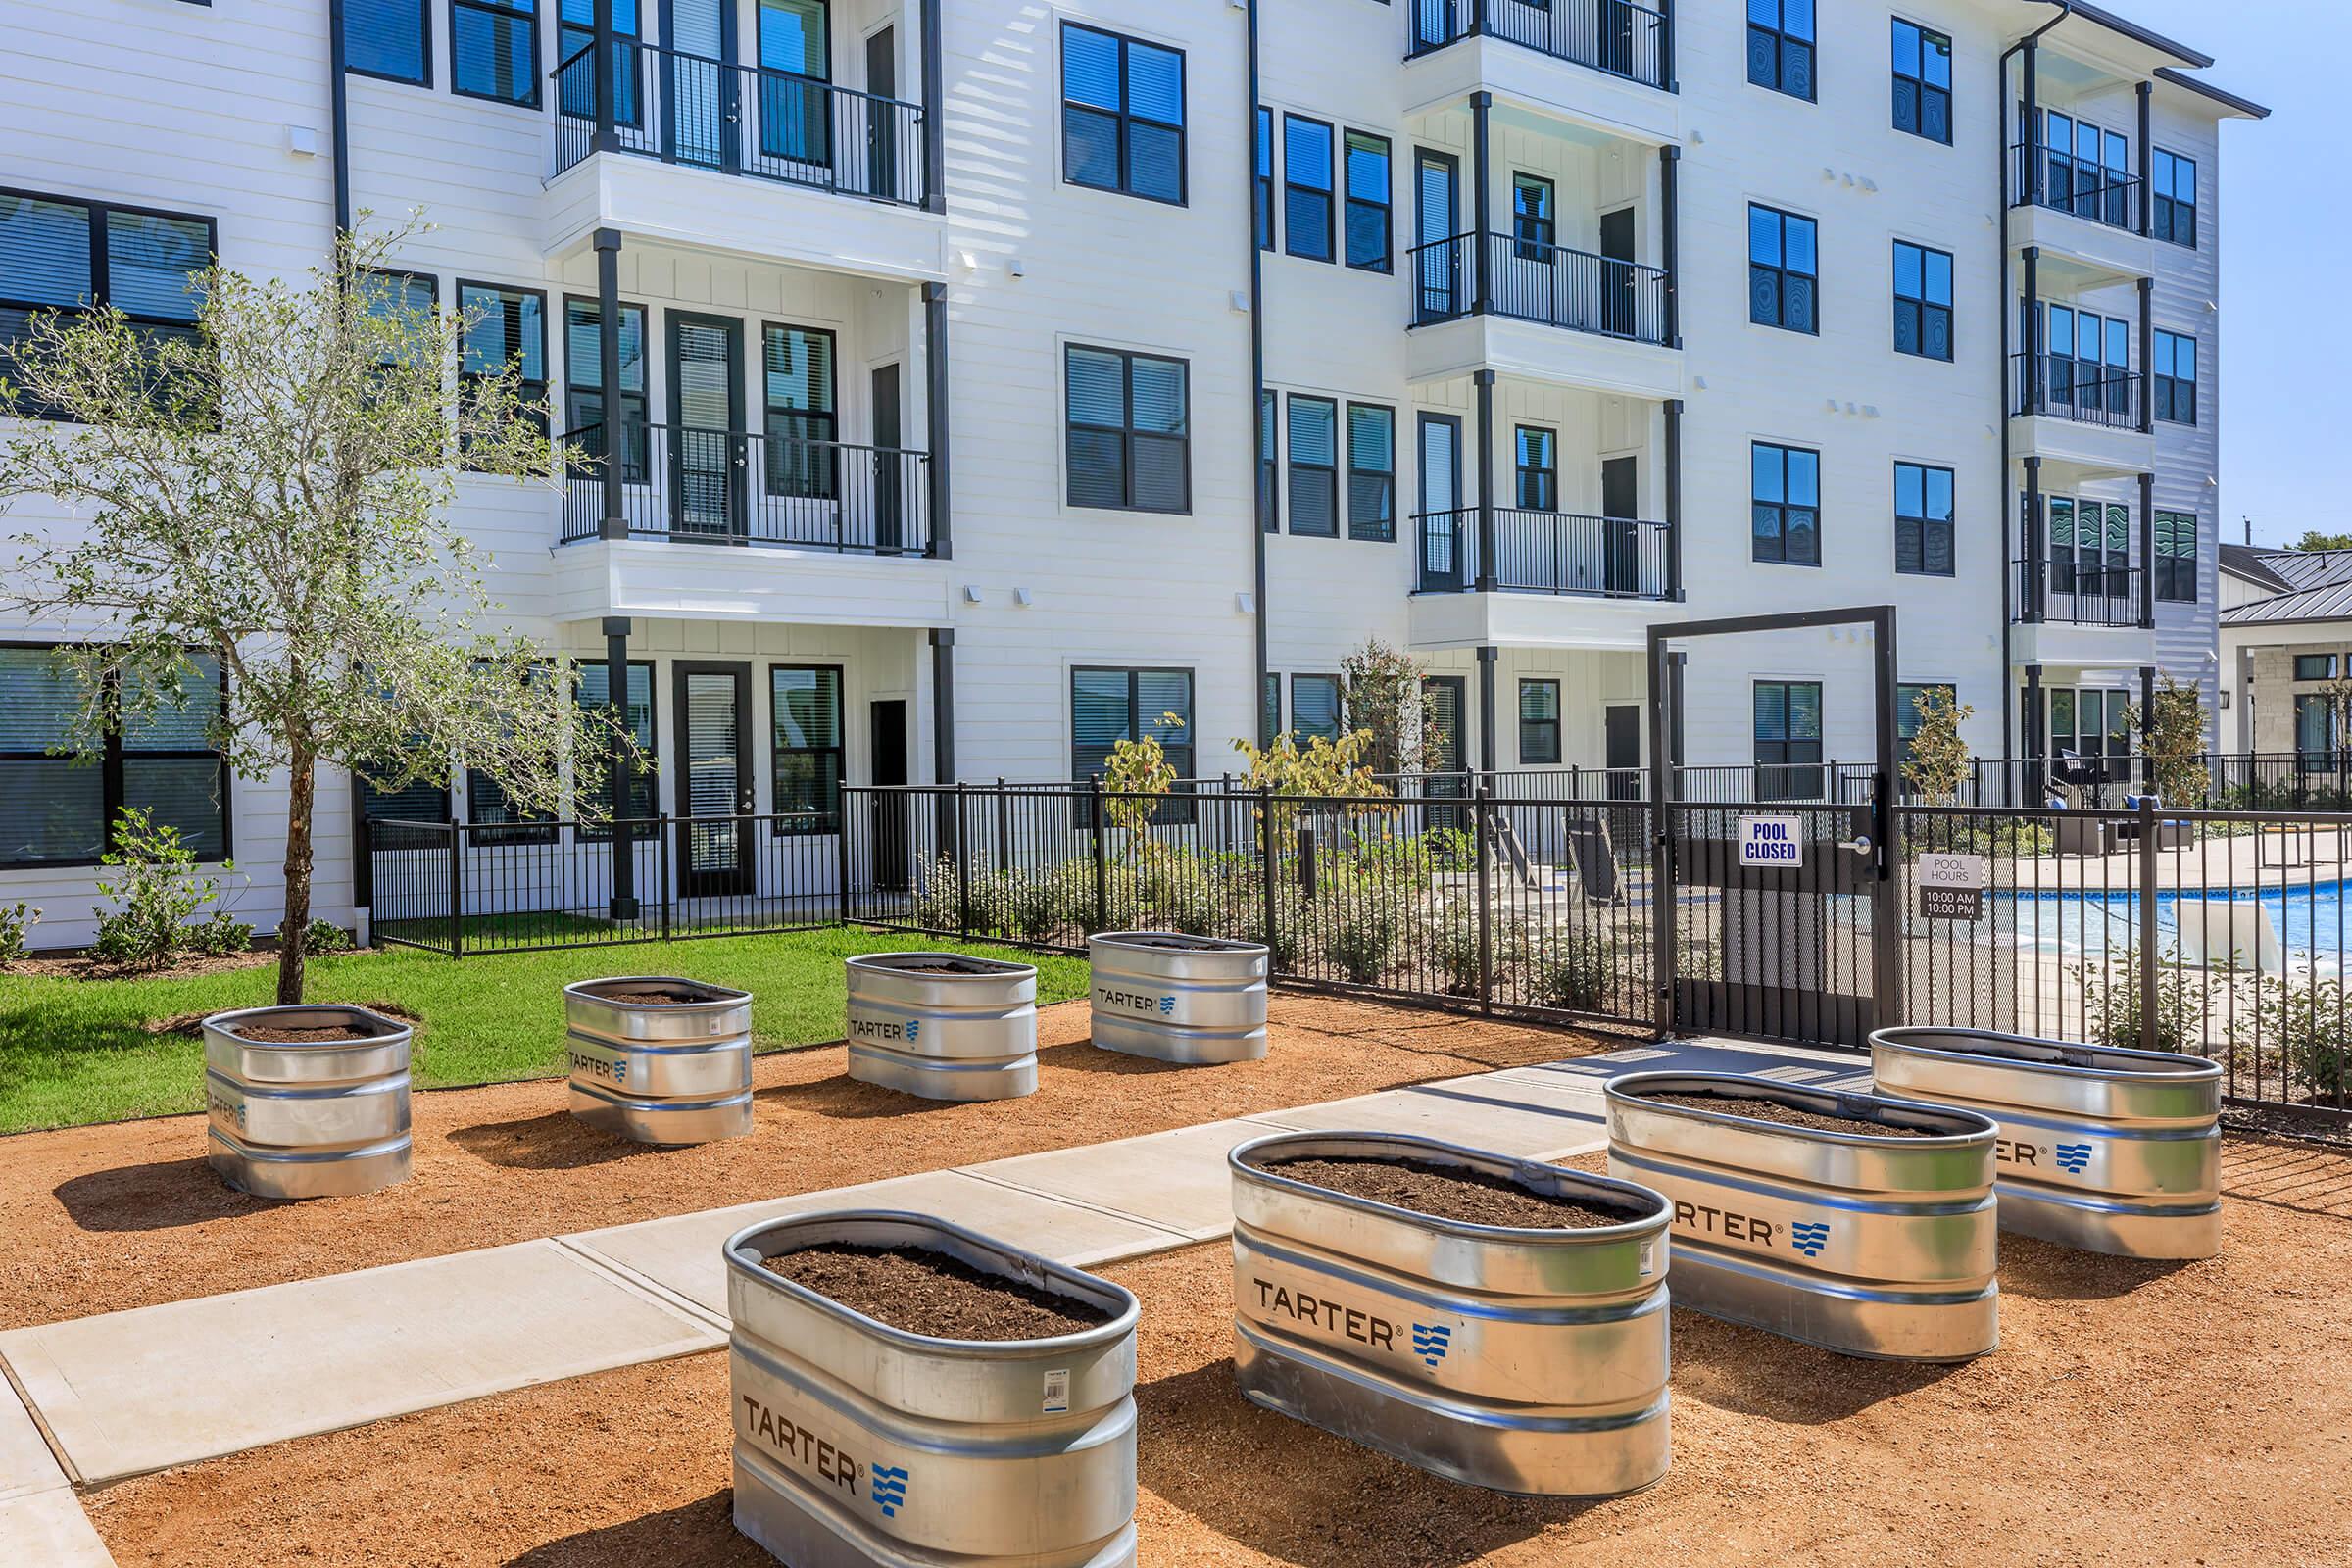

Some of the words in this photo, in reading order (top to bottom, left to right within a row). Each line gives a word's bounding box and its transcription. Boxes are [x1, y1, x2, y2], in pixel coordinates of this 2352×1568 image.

[1753, 823, 1788, 840] POOL
[1745, 842, 1796, 859] CLOSED
[1935, 859, 1965, 870] POOL
[1931, 870, 1969, 882] HOURS
[1927, 892, 1954, 903] 10:00
[1956, 893, 1975, 904] AM
[1928, 903, 1955, 913] 10:00
[1957, 905, 1974, 915] PM
